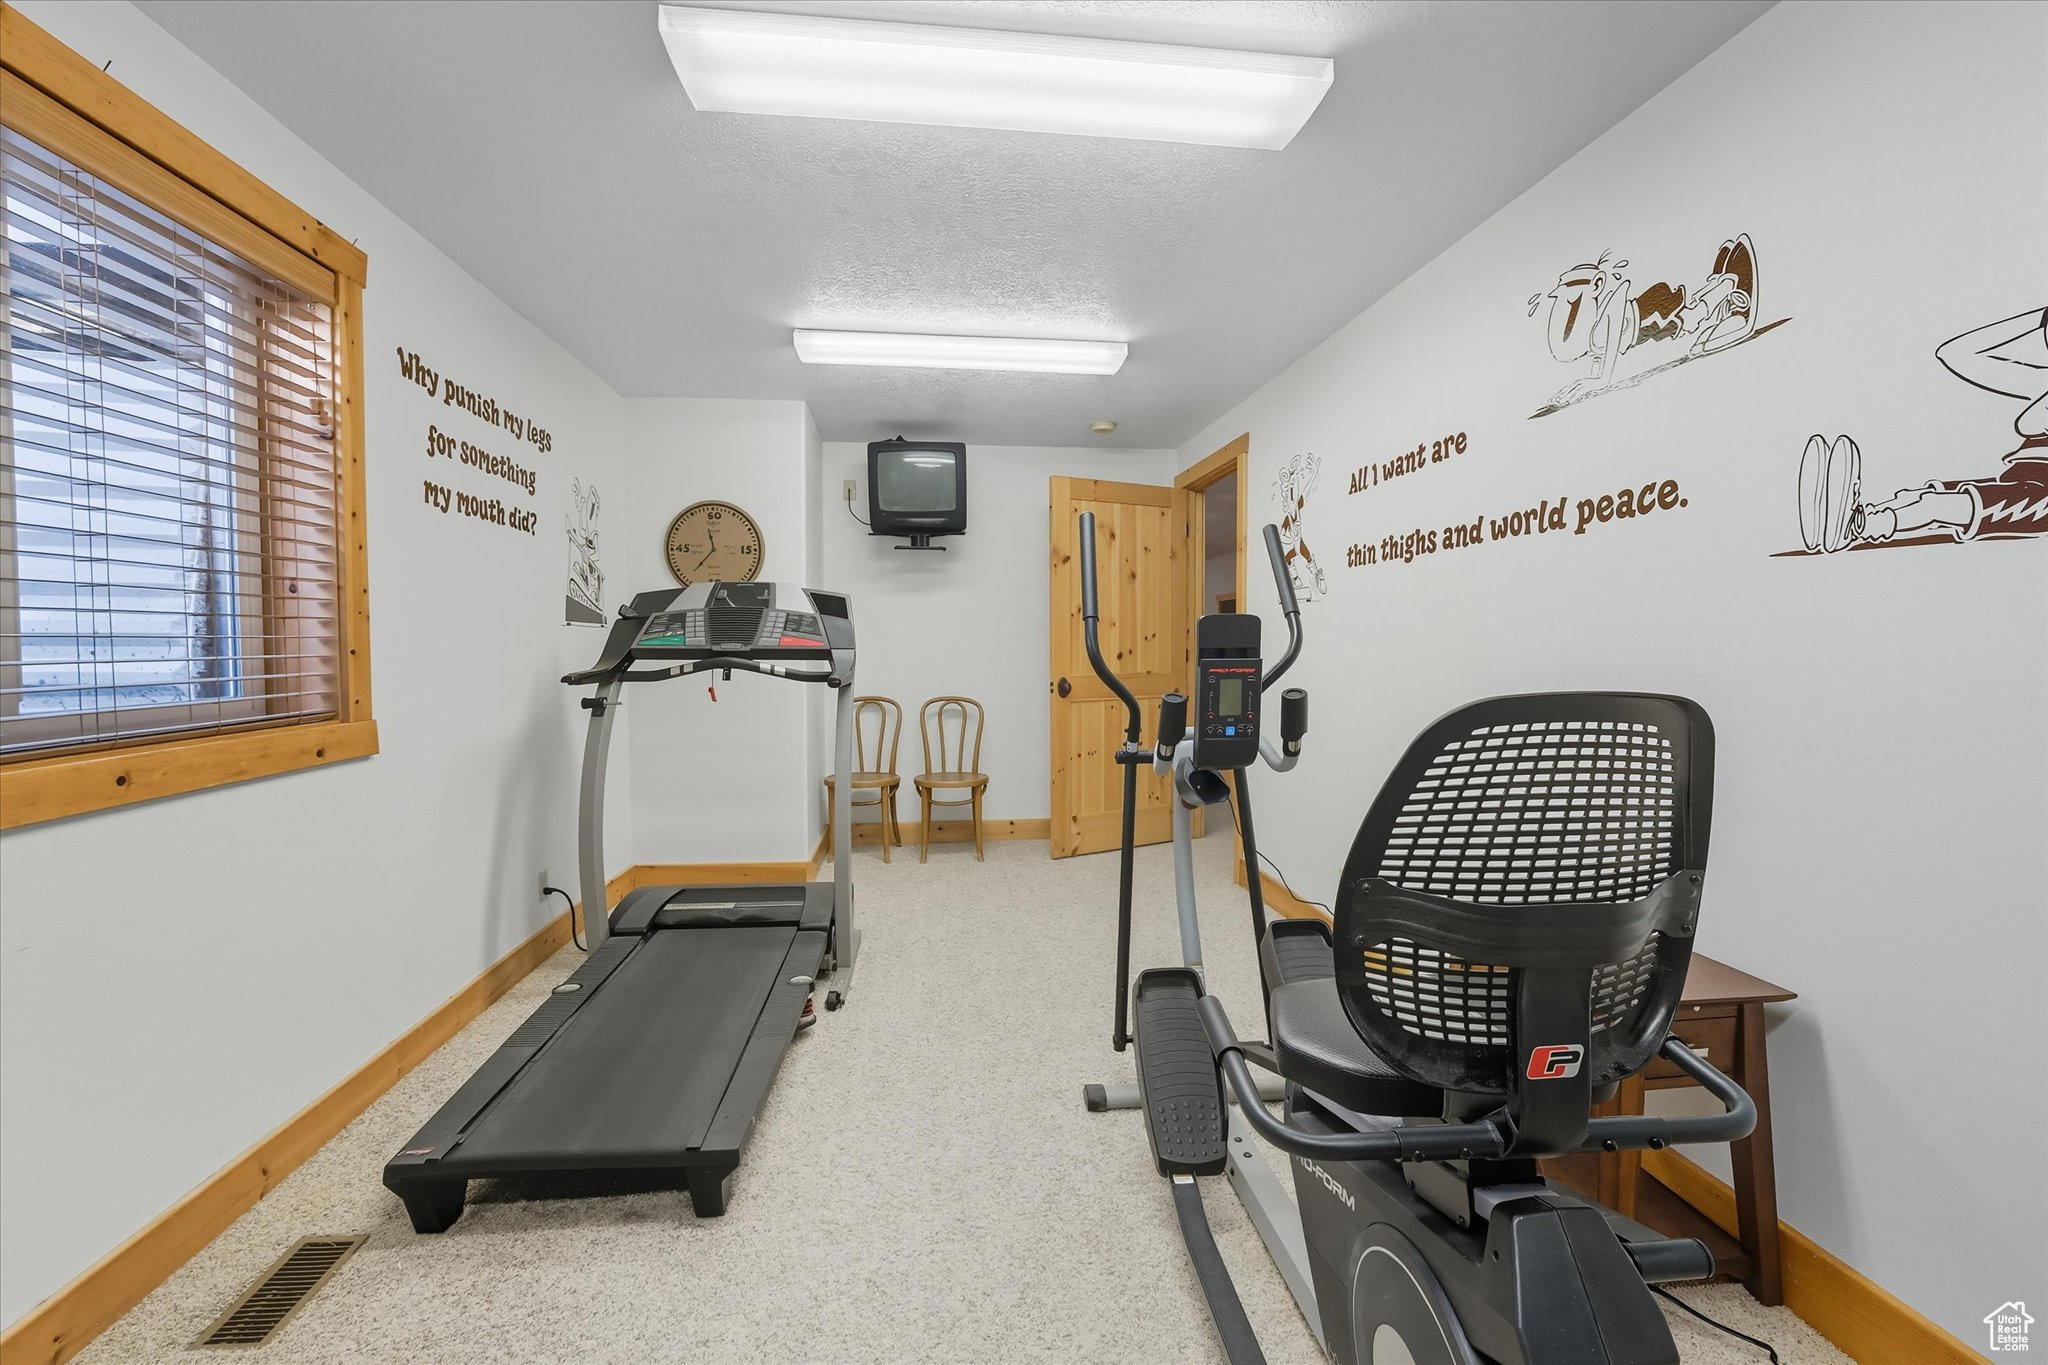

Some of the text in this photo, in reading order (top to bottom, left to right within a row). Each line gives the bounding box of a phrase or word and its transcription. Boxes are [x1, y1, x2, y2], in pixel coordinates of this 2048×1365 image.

[396, 346, 552, 454] Why punish my legs
[426, 424, 537, 496] for something
[1348, 466, 1370, 495] All
[1382, 442, 1427, 478] want
[1431, 431, 1468, 464] are
[423, 479, 538, 536] my mouth did?
[1346, 478, 1689, 568] thin thighs and world peace.
[675, 543, 690, 553] 45
[740, 545, 753, 555] 15
